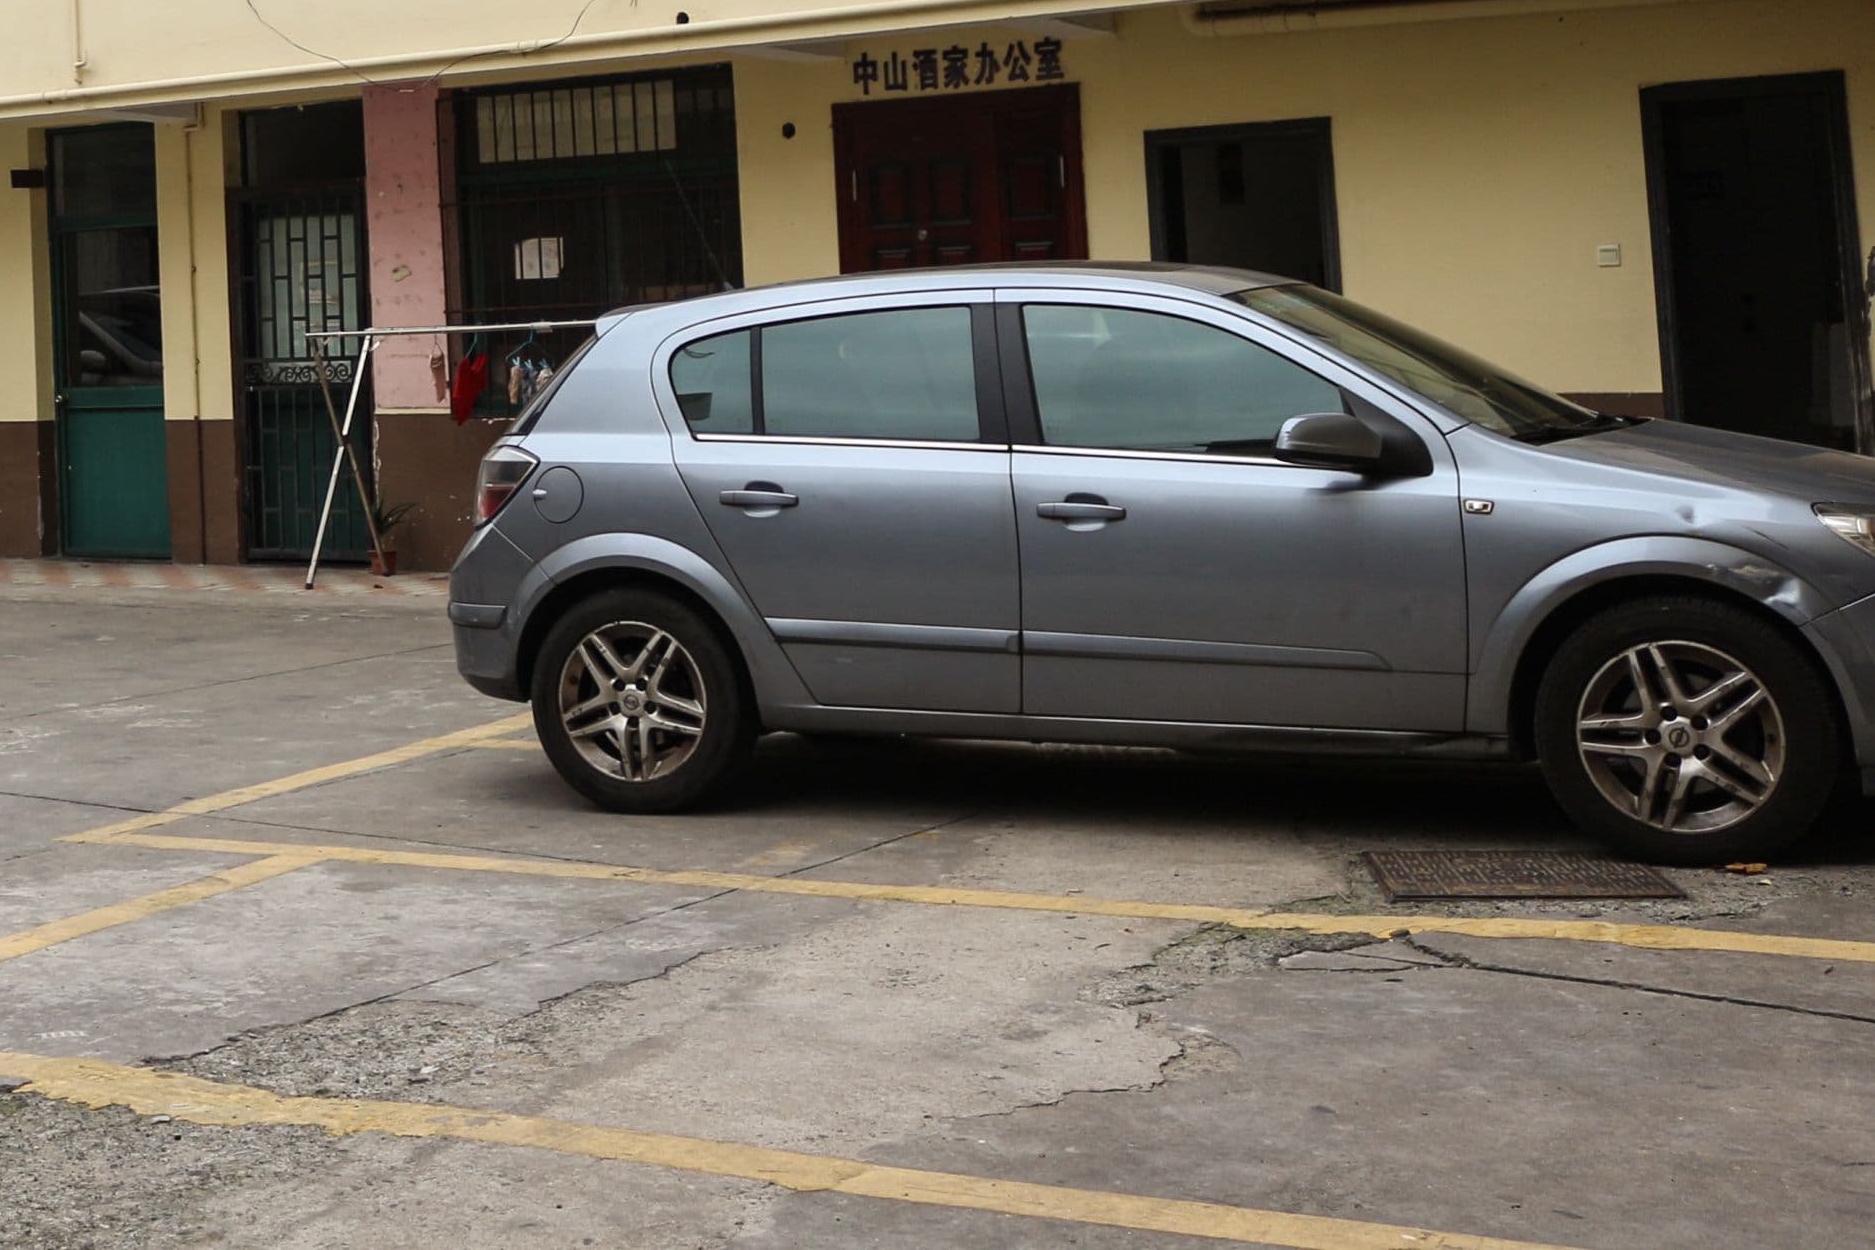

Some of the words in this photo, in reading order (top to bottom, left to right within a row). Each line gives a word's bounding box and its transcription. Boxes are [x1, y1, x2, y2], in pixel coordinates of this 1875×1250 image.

[852, 37, 1065, 95] 中山酒家办公室
